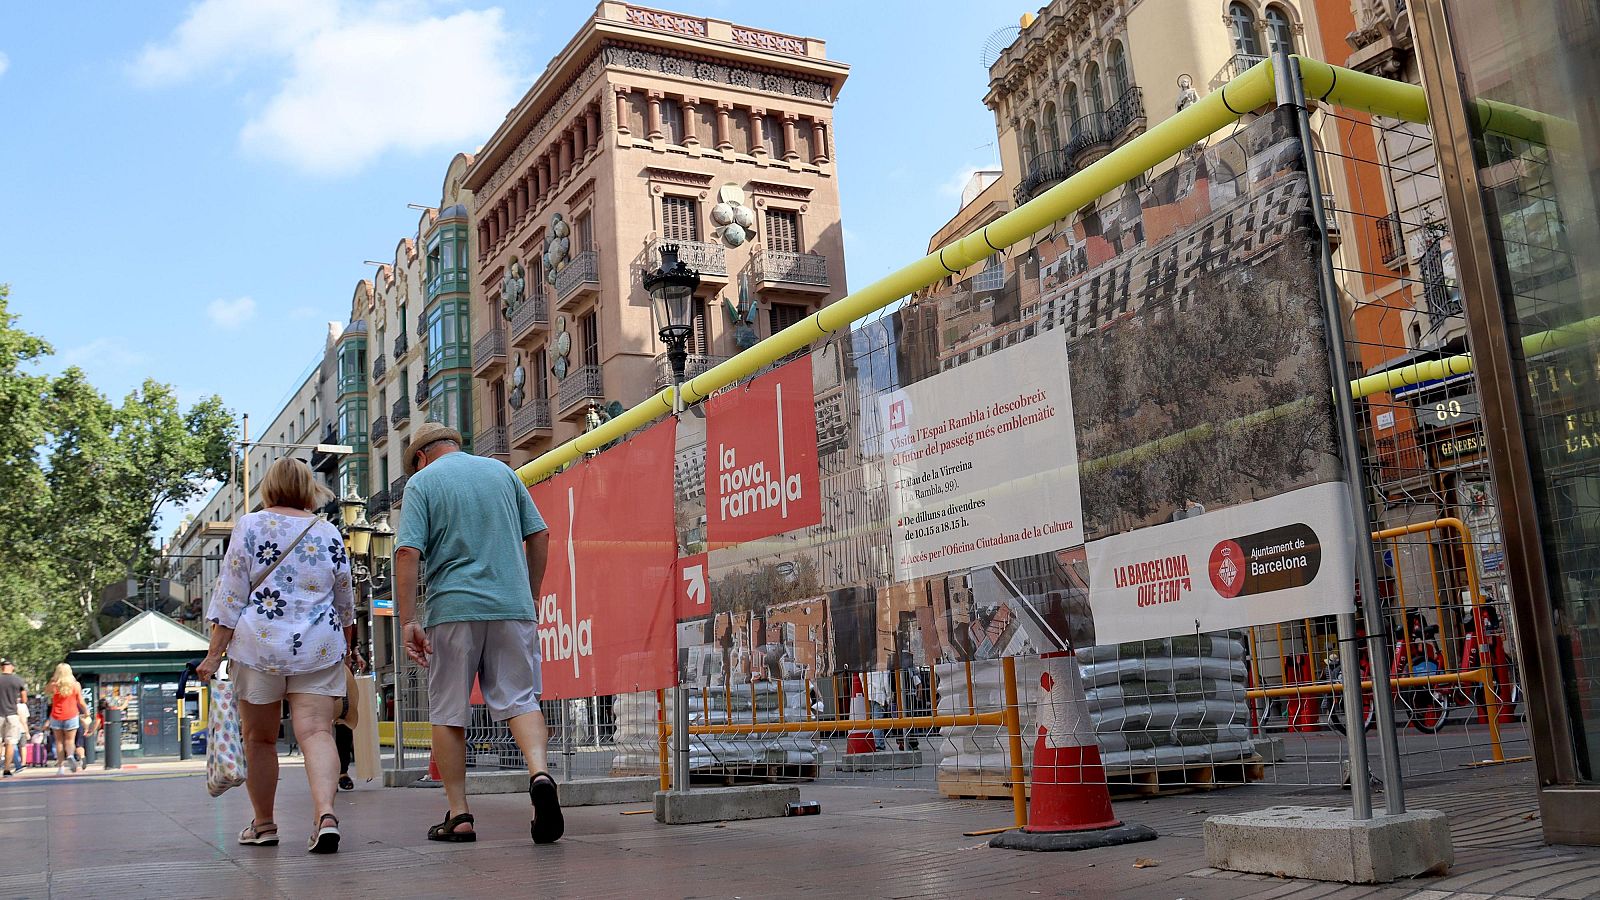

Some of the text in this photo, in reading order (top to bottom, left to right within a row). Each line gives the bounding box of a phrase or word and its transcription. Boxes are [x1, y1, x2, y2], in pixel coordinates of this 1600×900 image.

[890, 388, 1047, 450] Visita l'Espai Rambla i descobreix
[1436, 400, 1461, 420] 80
[892, 404, 1055, 467] el futur del passeig més emblemàtic
[719, 443, 736, 472] la
[922, 471, 931, 483] de
[931, 469, 939, 480] la
[940, 460, 973, 477] Virreina
[720, 461, 765, 495] nova
[915, 483, 944, 499] Rambla,
[944, 479, 960, 493] 99).
[904, 498, 986, 526] De dilluns a divendres
[905, 516, 969, 541] de 10.15 a 18.15 h.
[907, 520, 1074, 565] Accés per l'Oficina Ciutadana de la Cultura
[1250, 538, 1305, 560] Ajuntament de
[1114, 554, 1190, 589] LA BARCELONA
[1251, 553, 1307, 577] Barcelona
[1137, 579, 1181, 608] QUE FEM
[539, 593, 557, 625] va
